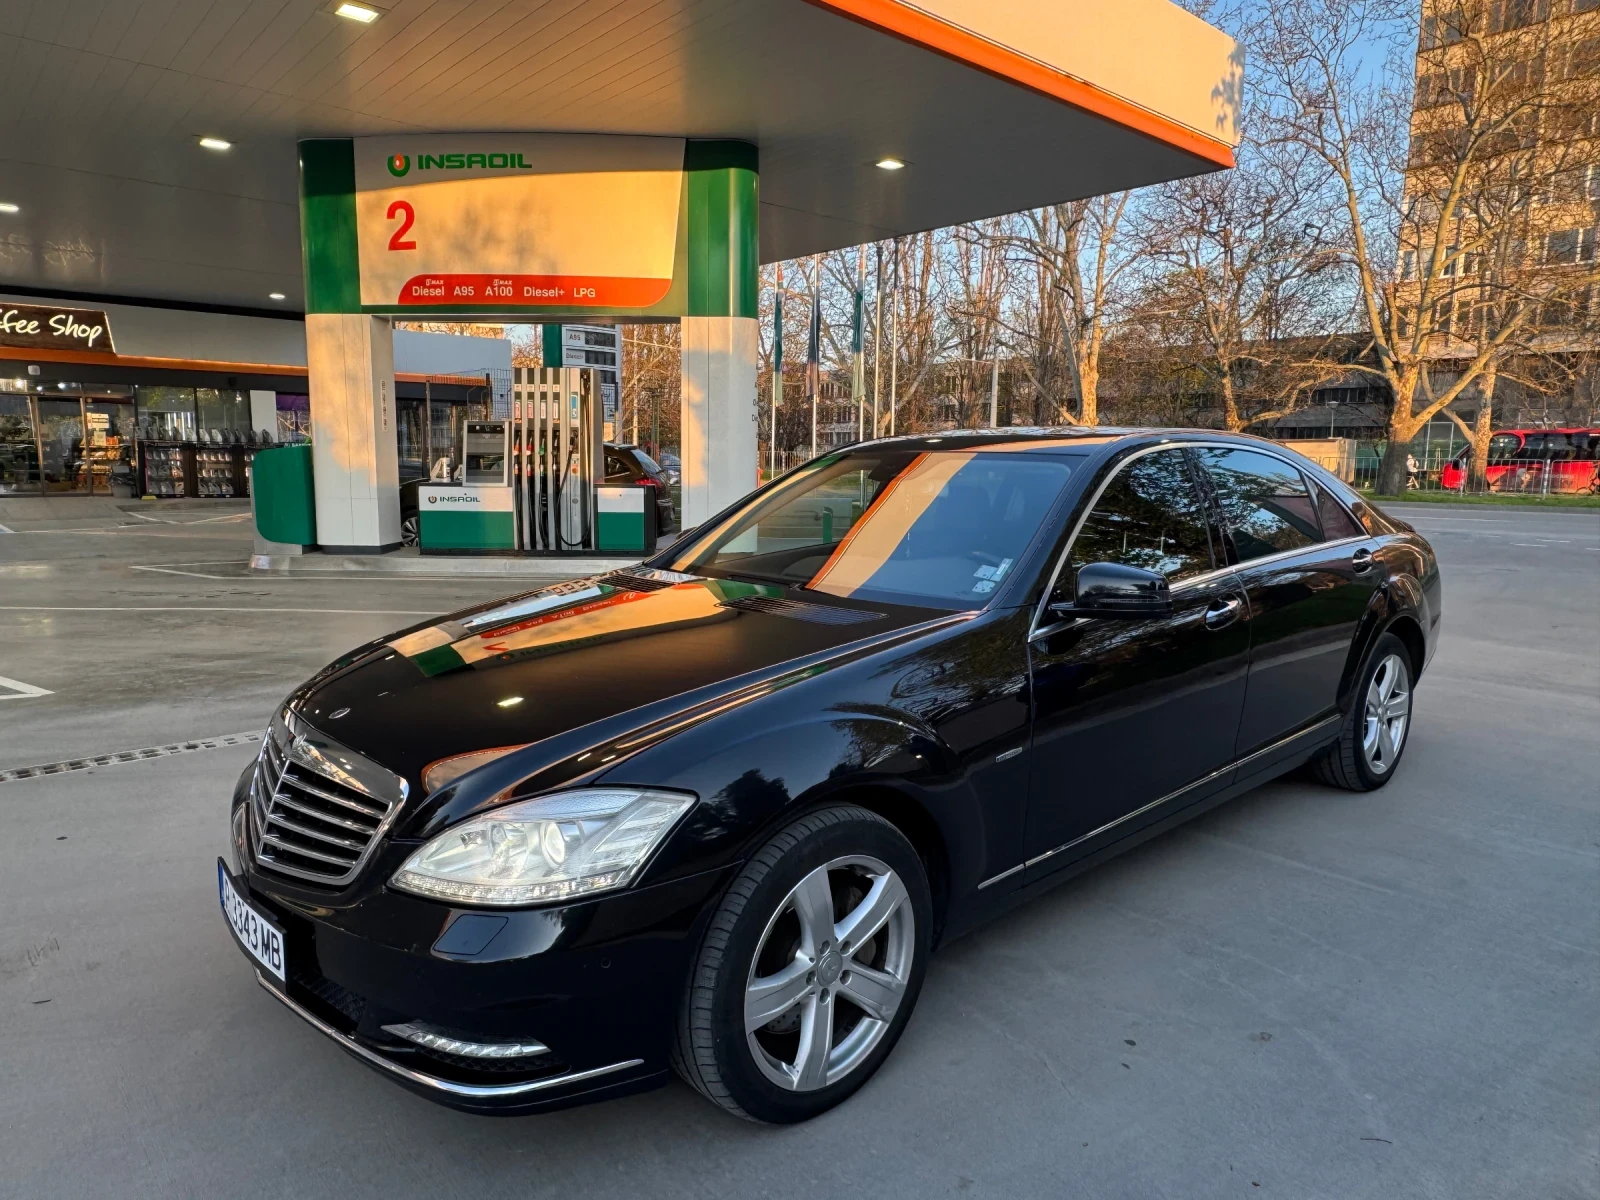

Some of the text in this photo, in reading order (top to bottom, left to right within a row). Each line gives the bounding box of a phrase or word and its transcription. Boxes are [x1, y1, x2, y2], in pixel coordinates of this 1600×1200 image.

[417, 153, 533, 170] INSAOIL
[386, 200, 417, 251] 2
[412, 285, 596, 299] Diesel A95 A100 Diesel+ LPG
[49, 314, 103, 348] Shop
[260, 922, 281, 972] MB
